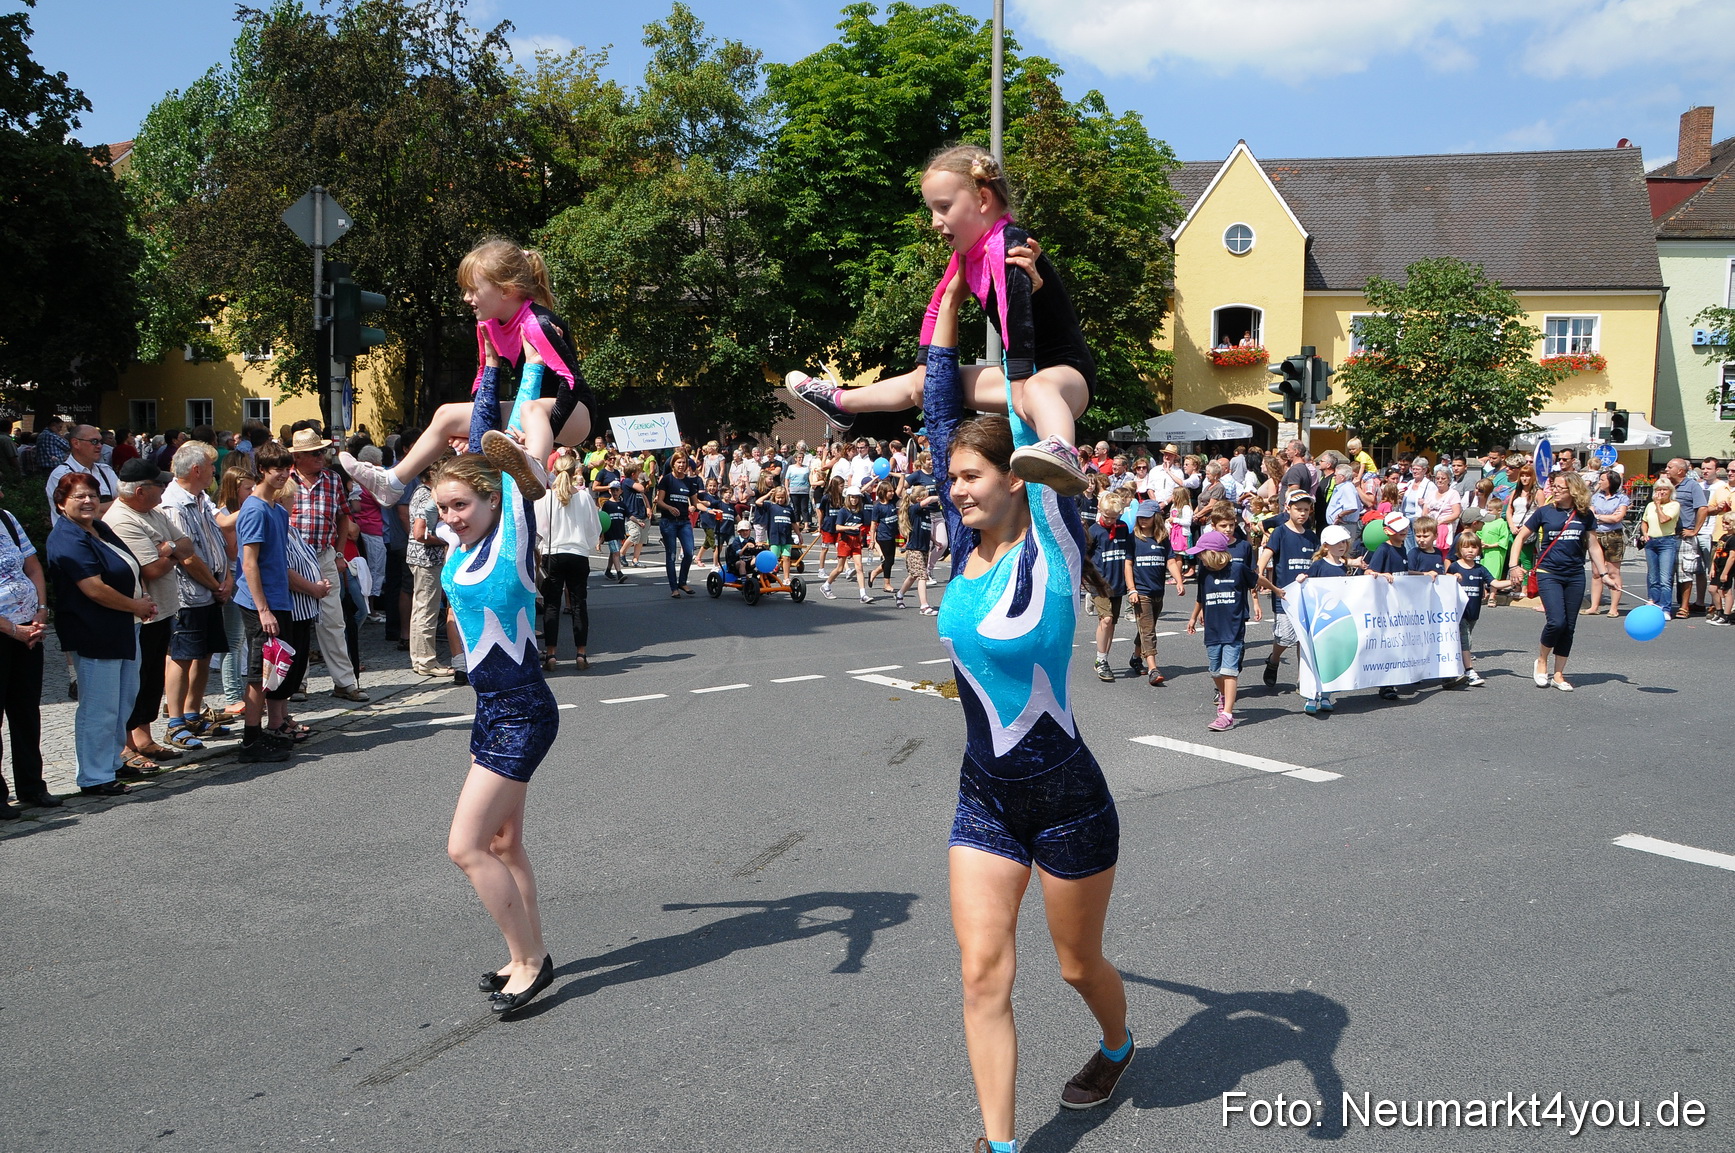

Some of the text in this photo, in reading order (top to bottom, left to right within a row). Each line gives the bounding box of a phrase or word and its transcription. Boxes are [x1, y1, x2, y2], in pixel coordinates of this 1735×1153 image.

[1364, 613, 1387, 628] Freie
[1365, 635, 1377, 649] im
[1380, 634, 1398, 649] Haus
[1436, 653, 1453, 662] Tel.
